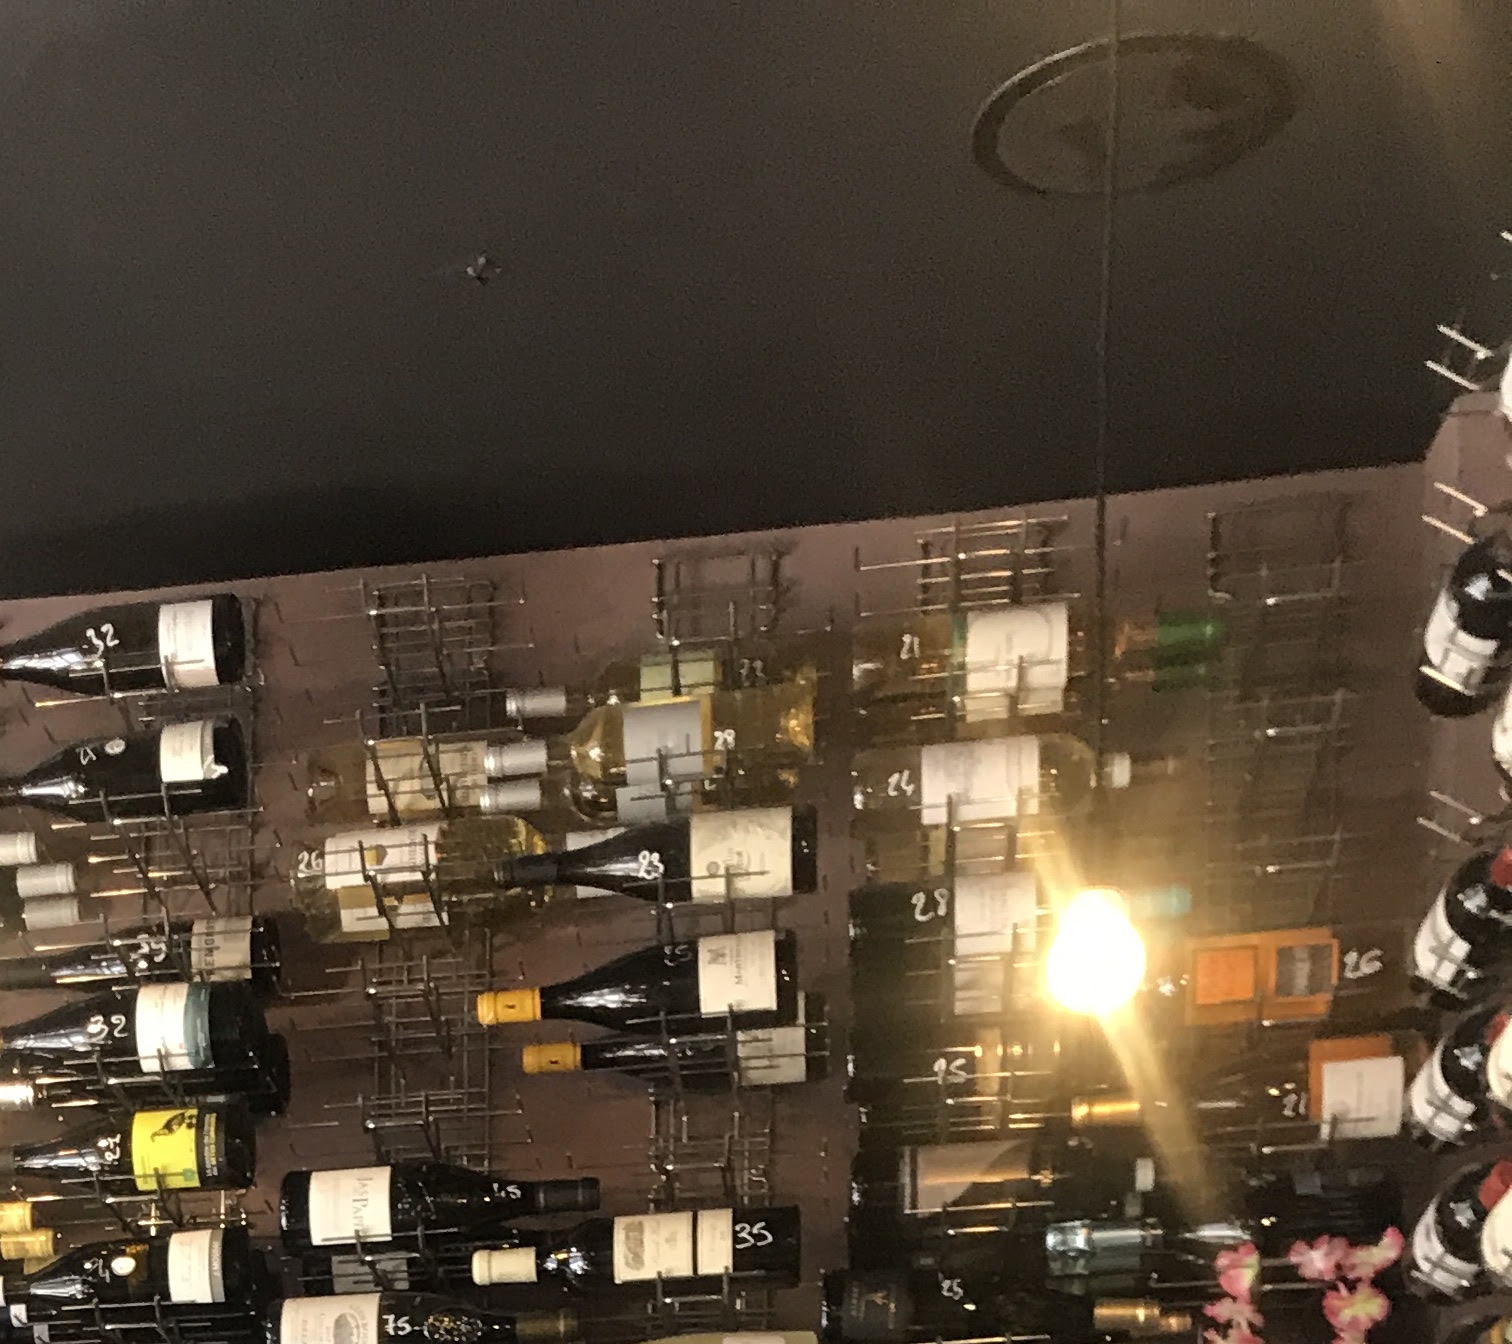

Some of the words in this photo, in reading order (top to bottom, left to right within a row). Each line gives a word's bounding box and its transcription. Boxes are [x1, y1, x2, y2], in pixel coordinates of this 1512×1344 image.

[85, 622, 121, 659] 32
[910, 887, 951, 924] 28
[90, 1014, 130, 1042] 32
[733, 1220, 775, 1250] 35
[380, 1312, 413, 1337] 75
